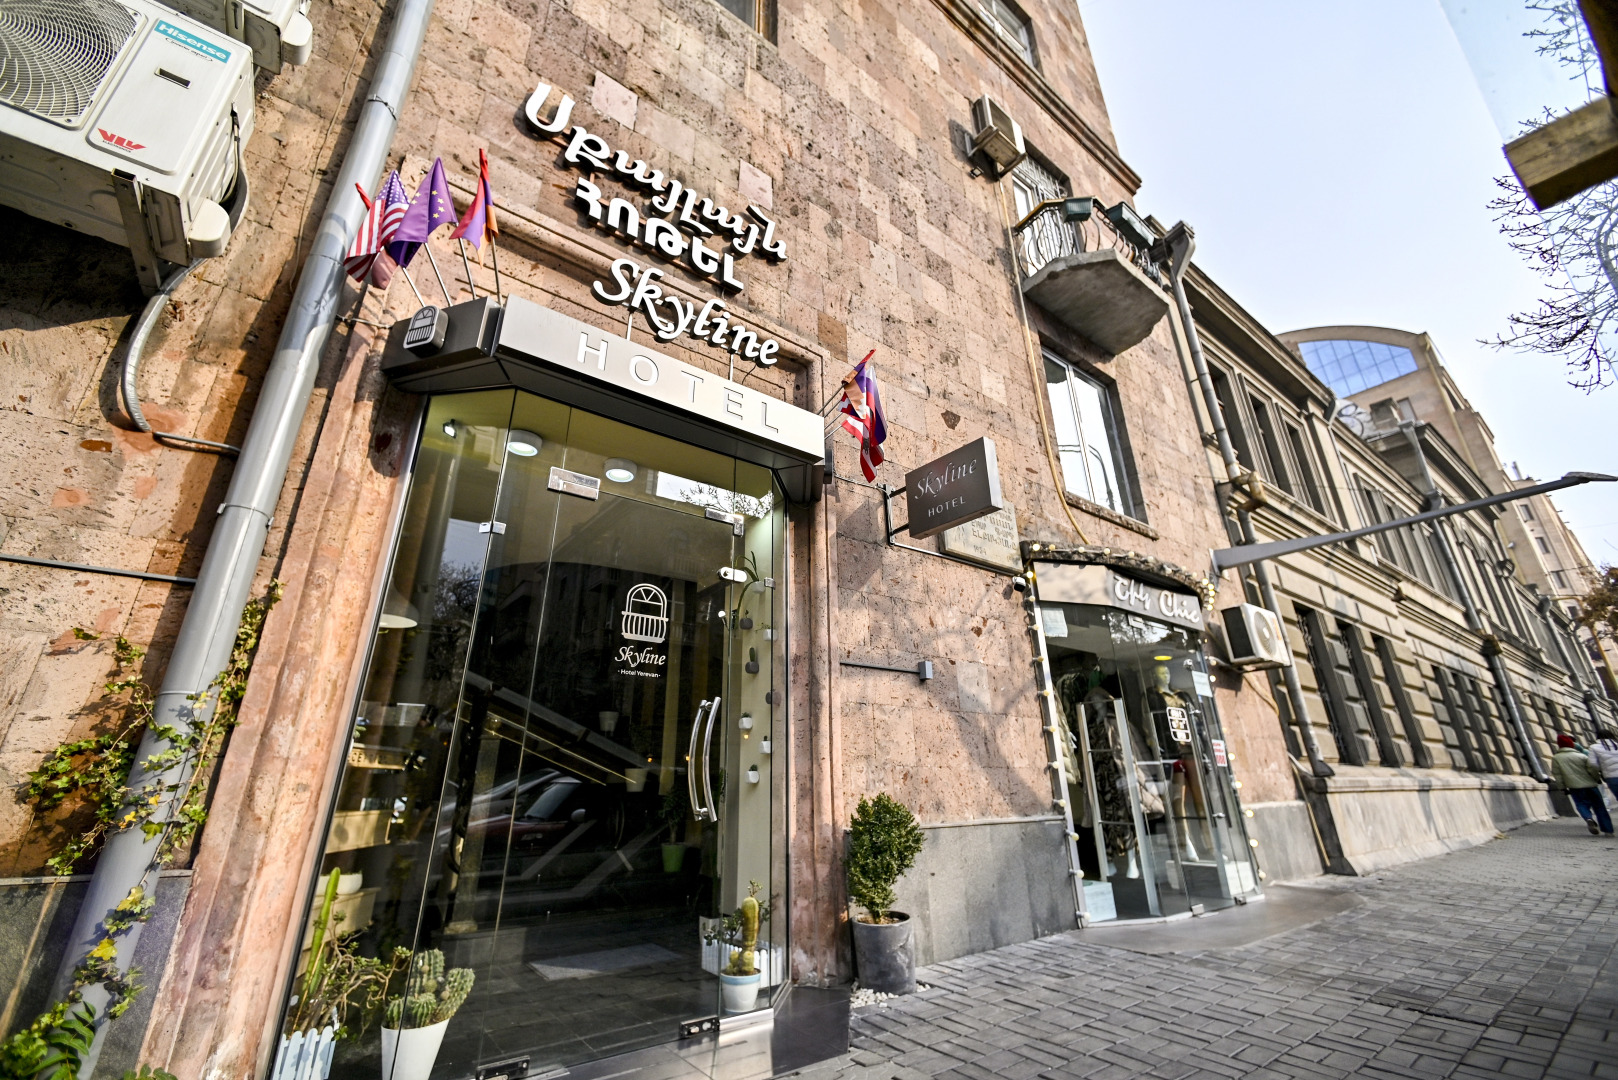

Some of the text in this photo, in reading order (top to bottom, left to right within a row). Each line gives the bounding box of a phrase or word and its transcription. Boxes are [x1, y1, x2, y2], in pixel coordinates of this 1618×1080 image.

[159, 23, 227, 60] Hisense
[592, 258, 780, 366] Skyline
[577, 331, 779, 434] HOTEL
[914, 459, 977, 500] Skyline
[928, 496, 966, 517] HOTEL
[1160, 589, 1200, 623] Chic
[614, 645, 666, 668] Skyline
